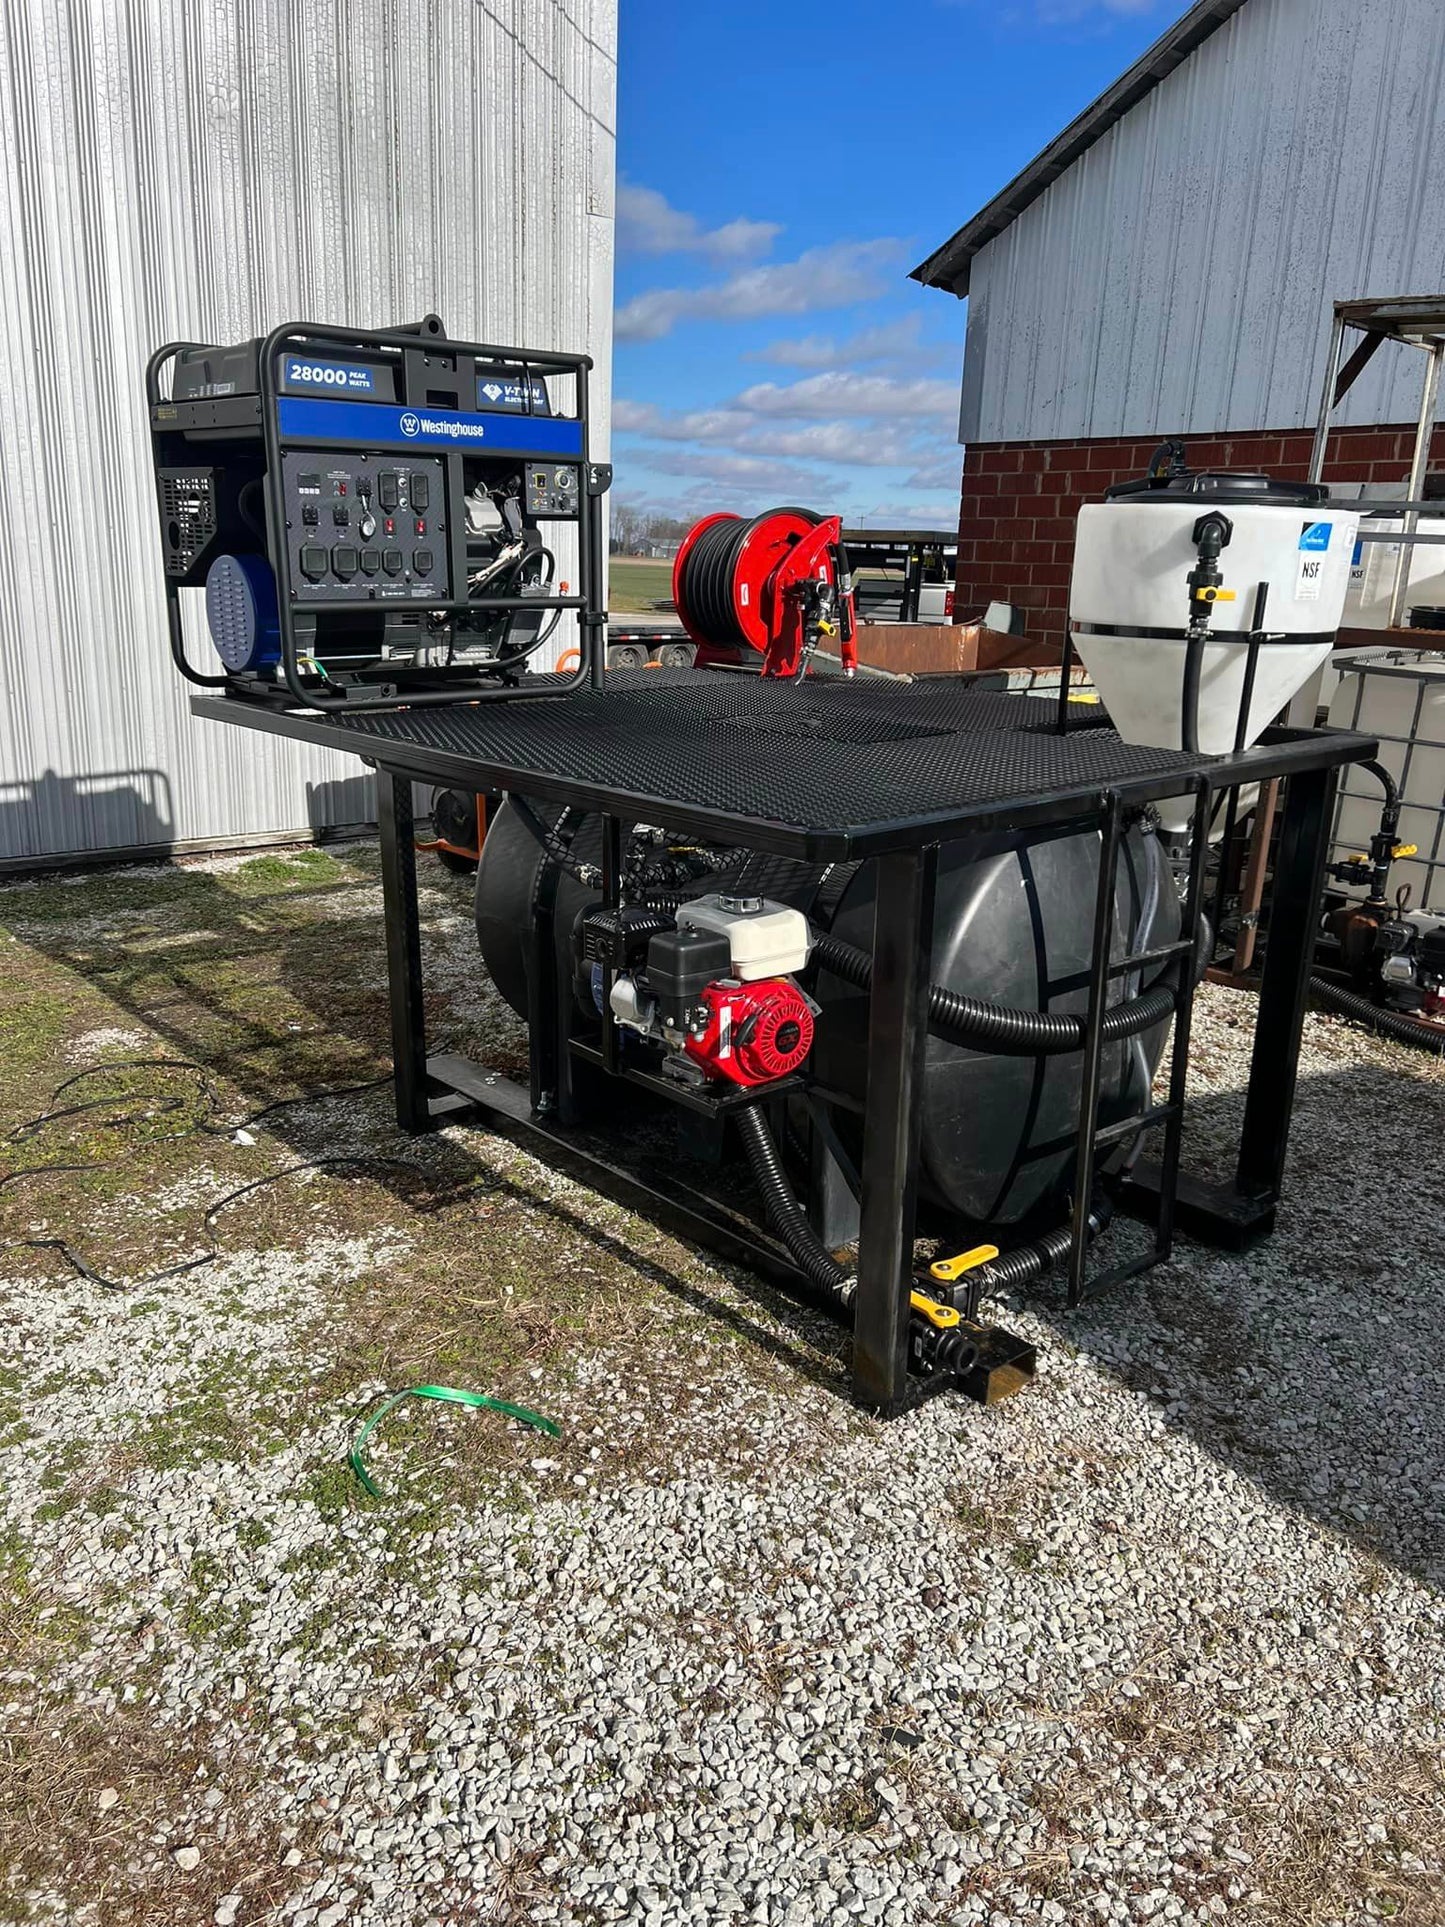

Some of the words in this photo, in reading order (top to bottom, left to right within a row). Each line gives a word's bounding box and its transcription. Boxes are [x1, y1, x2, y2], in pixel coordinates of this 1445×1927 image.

[290, 364, 347, 385] 28000
[349, 371, 367, 380] PEAK
[348, 379, 371, 388] WATTS
[504, 385, 540, 398] V-TWN
[420, 418, 484, 438] Westinghouse
[1302, 562, 1320, 578] NSF
[1351, 570, 1364, 578] NSF
